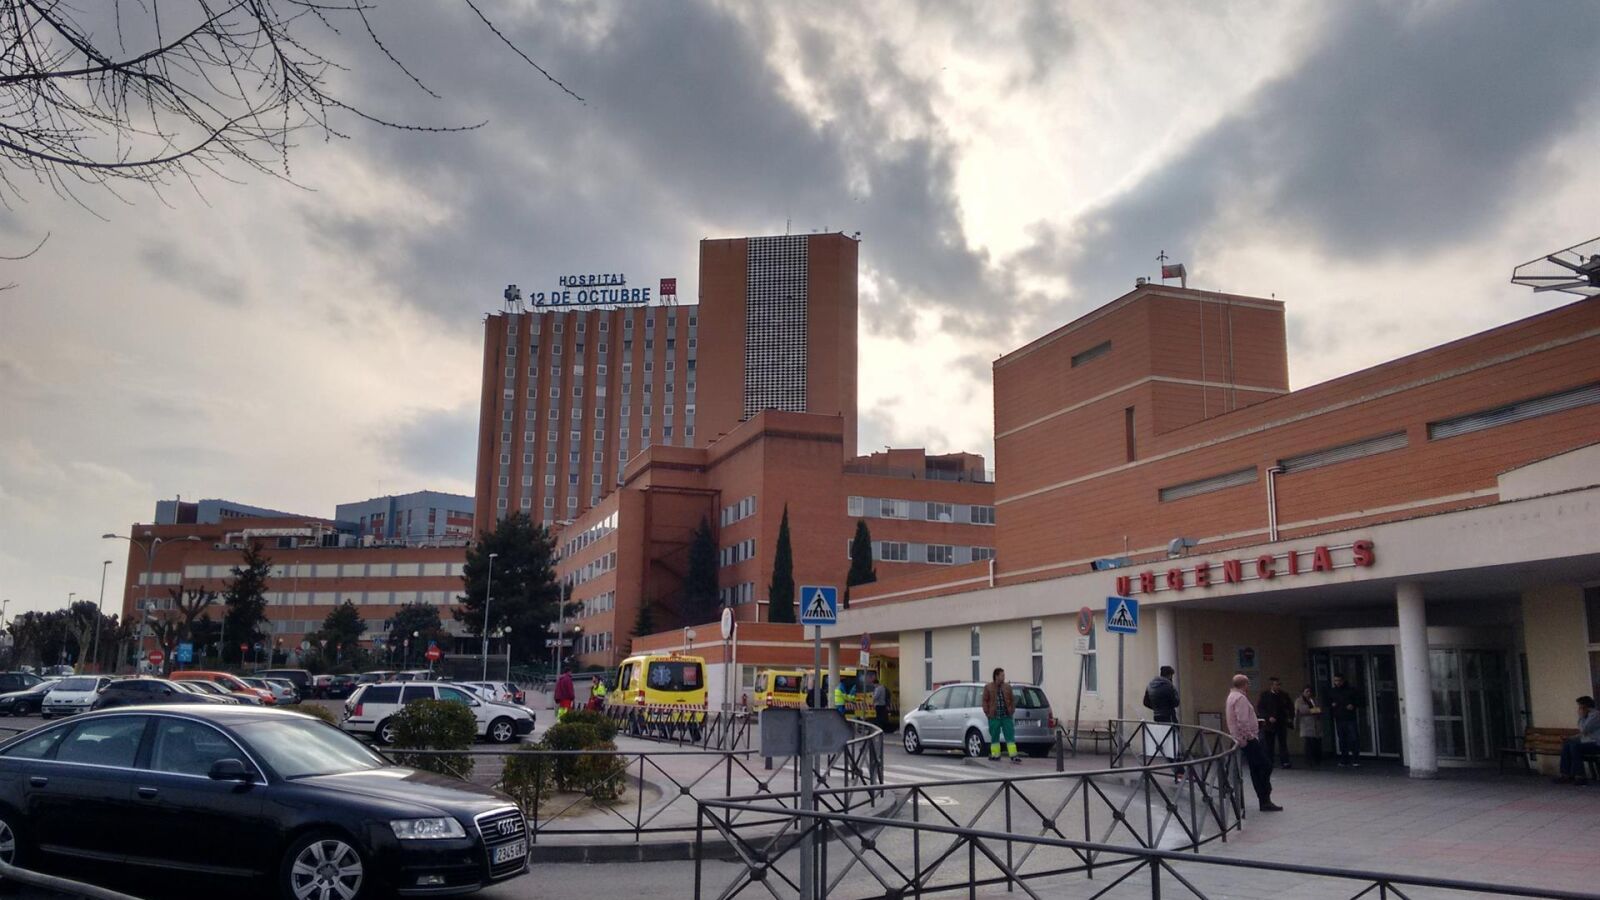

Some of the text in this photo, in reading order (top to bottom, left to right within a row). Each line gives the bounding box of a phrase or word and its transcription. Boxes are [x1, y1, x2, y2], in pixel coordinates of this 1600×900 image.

[559, 273, 626, 286] HOSPITAL
[530, 289, 651, 305] 12 DE OCTUBRE
[1116, 539, 1376, 597] URGENCIAS
